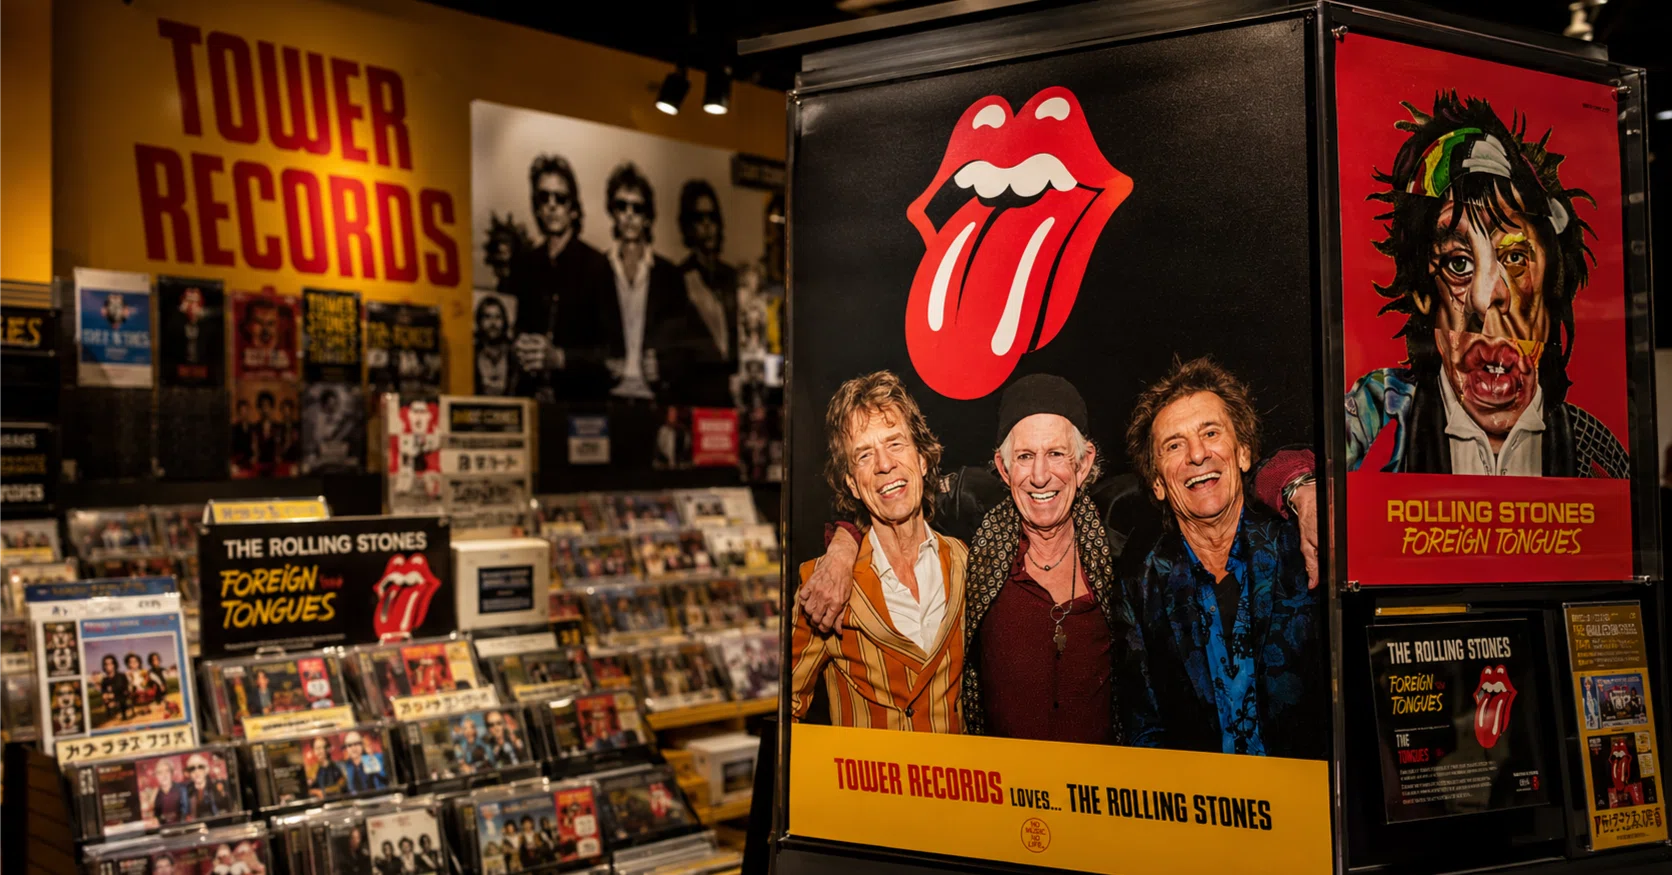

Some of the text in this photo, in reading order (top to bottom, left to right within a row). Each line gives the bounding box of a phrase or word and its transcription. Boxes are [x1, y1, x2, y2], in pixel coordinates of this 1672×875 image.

[157, 18, 413, 170] TOWER
[134, 143, 460, 287] RECORDS
[0, 316, 43, 346] ES
[1387, 500, 1595, 524] ROLLING STONES
[223, 532, 428, 559] THE ROLLING STONES
[1495, 528, 1583, 555] TONGUES
[221, 592, 336, 629] TONGUES
[1387, 636, 1511, 665] THE ROLLING STONES
[1390, 693, 1443, 715] TONGUES
[833, 757, 1273, 830] TOWER RECORDS LOVES... THE ROLLING STONES
